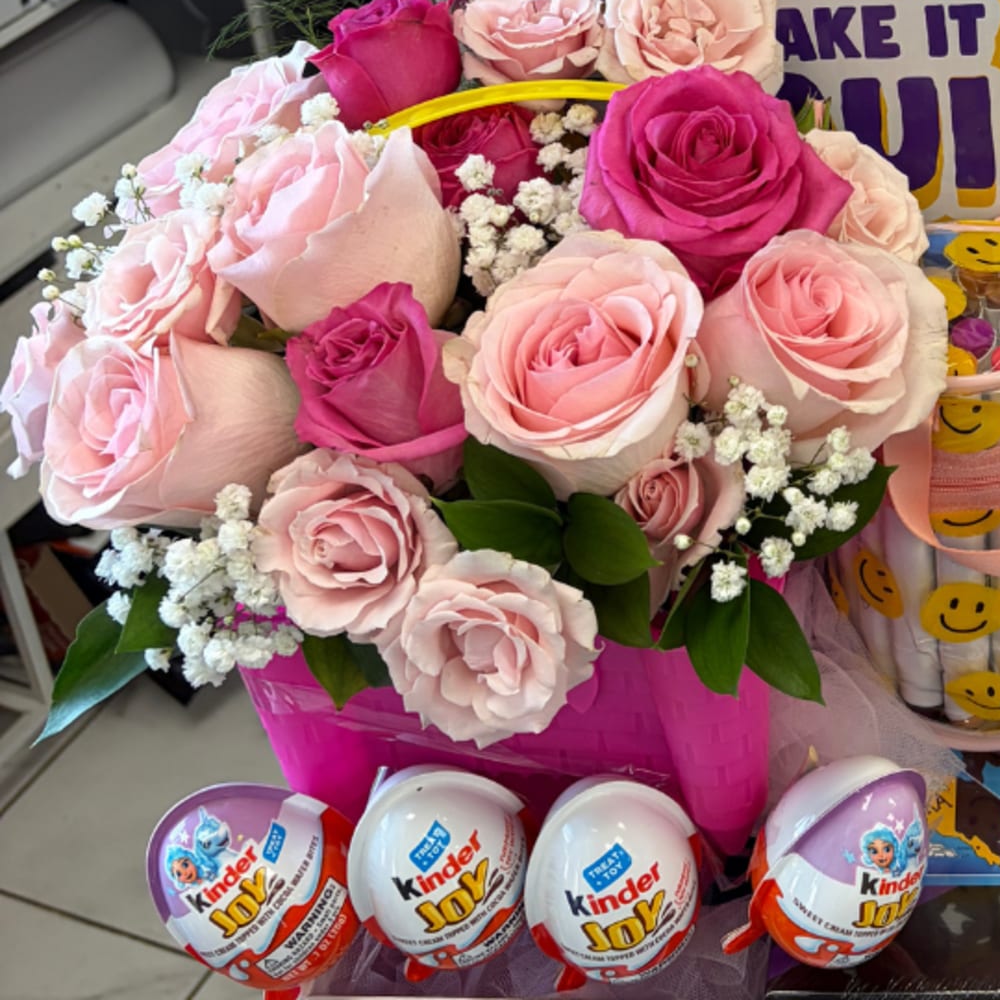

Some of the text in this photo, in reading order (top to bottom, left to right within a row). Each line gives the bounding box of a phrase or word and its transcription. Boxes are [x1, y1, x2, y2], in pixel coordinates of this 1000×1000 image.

[776, 3, 986, 62] AKE IT
[185, 845, 257, 914] kinder
[391, 829, 482, 901] kinder
[415, 857, 489, 934] JOY
[565, 861, 661, 917] kinder
[603, 862, 624, 880] TOY
[209, 866, 267, 940] JOY
[581, 889, 666, 952] JOY
